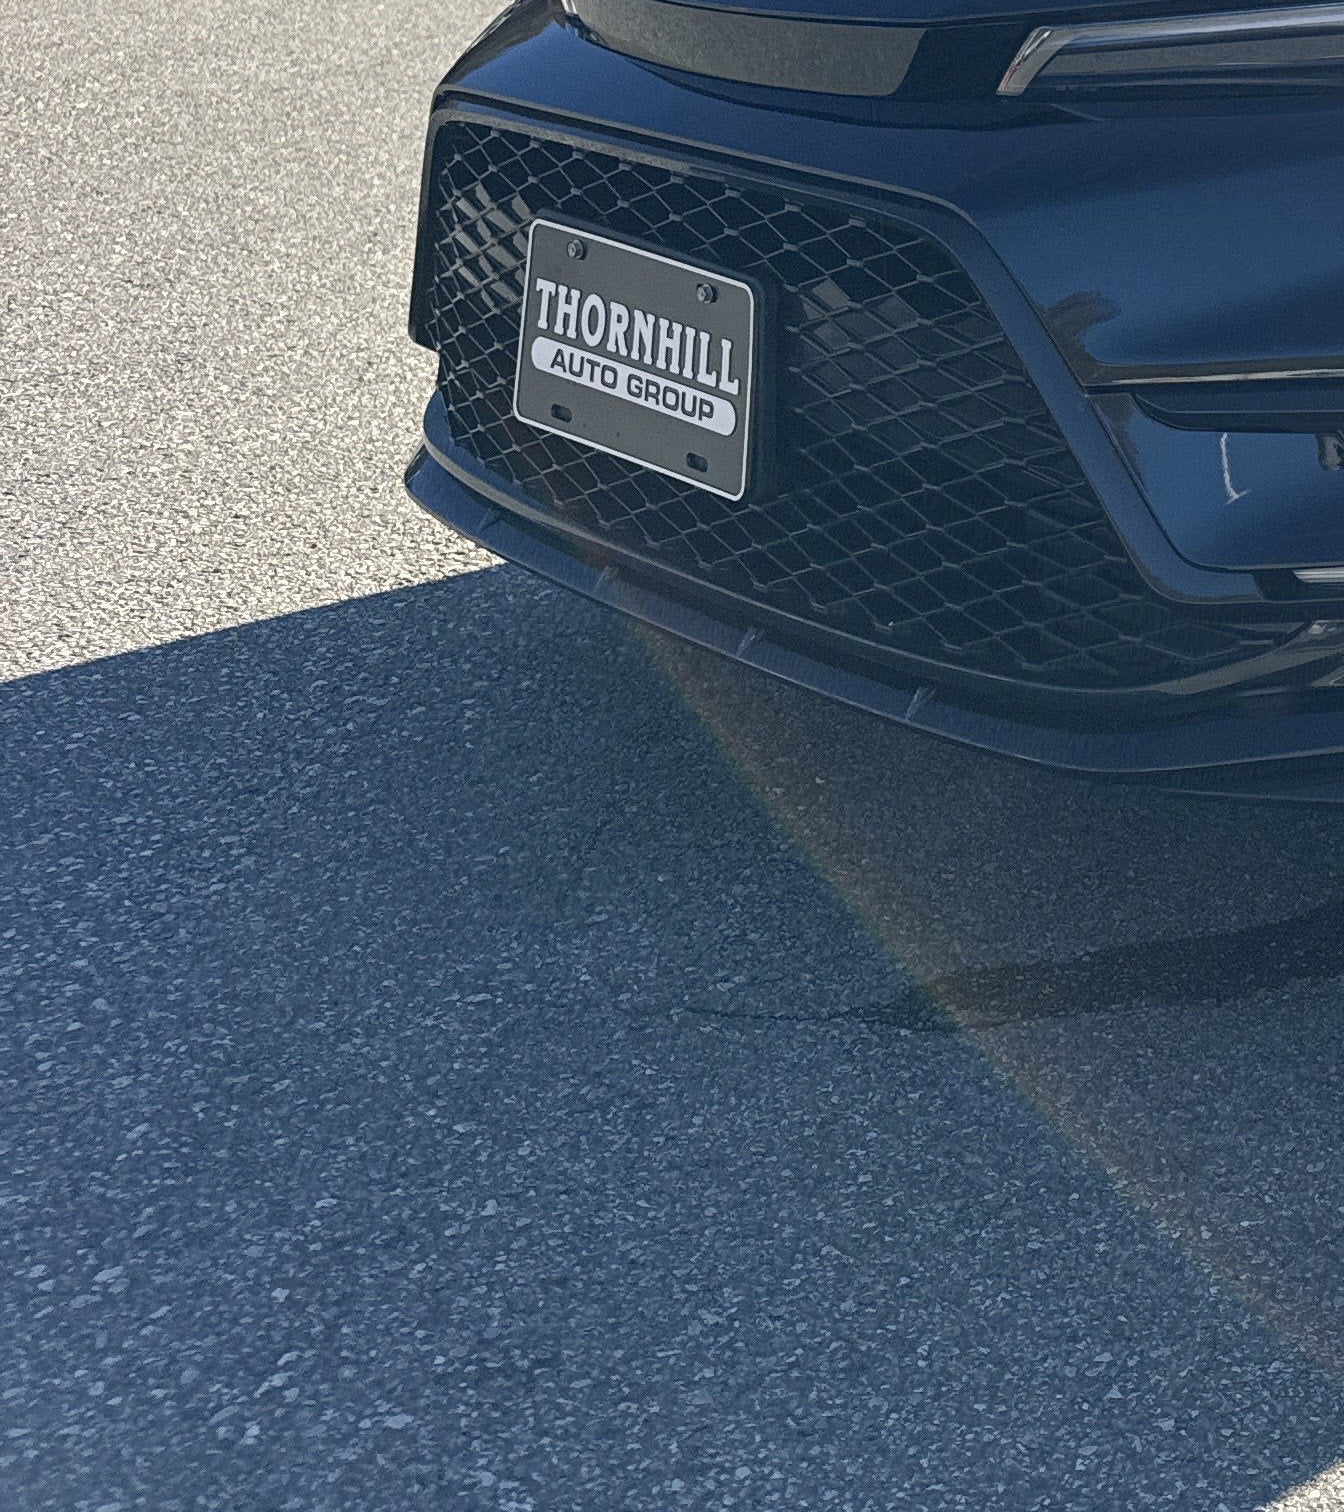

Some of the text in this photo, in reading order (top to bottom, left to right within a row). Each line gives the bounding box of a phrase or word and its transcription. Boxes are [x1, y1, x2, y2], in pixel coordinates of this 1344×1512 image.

[535, 277, 740, 396] THORNHILL
[550, 348, 715, 422] AUTO GROUP
